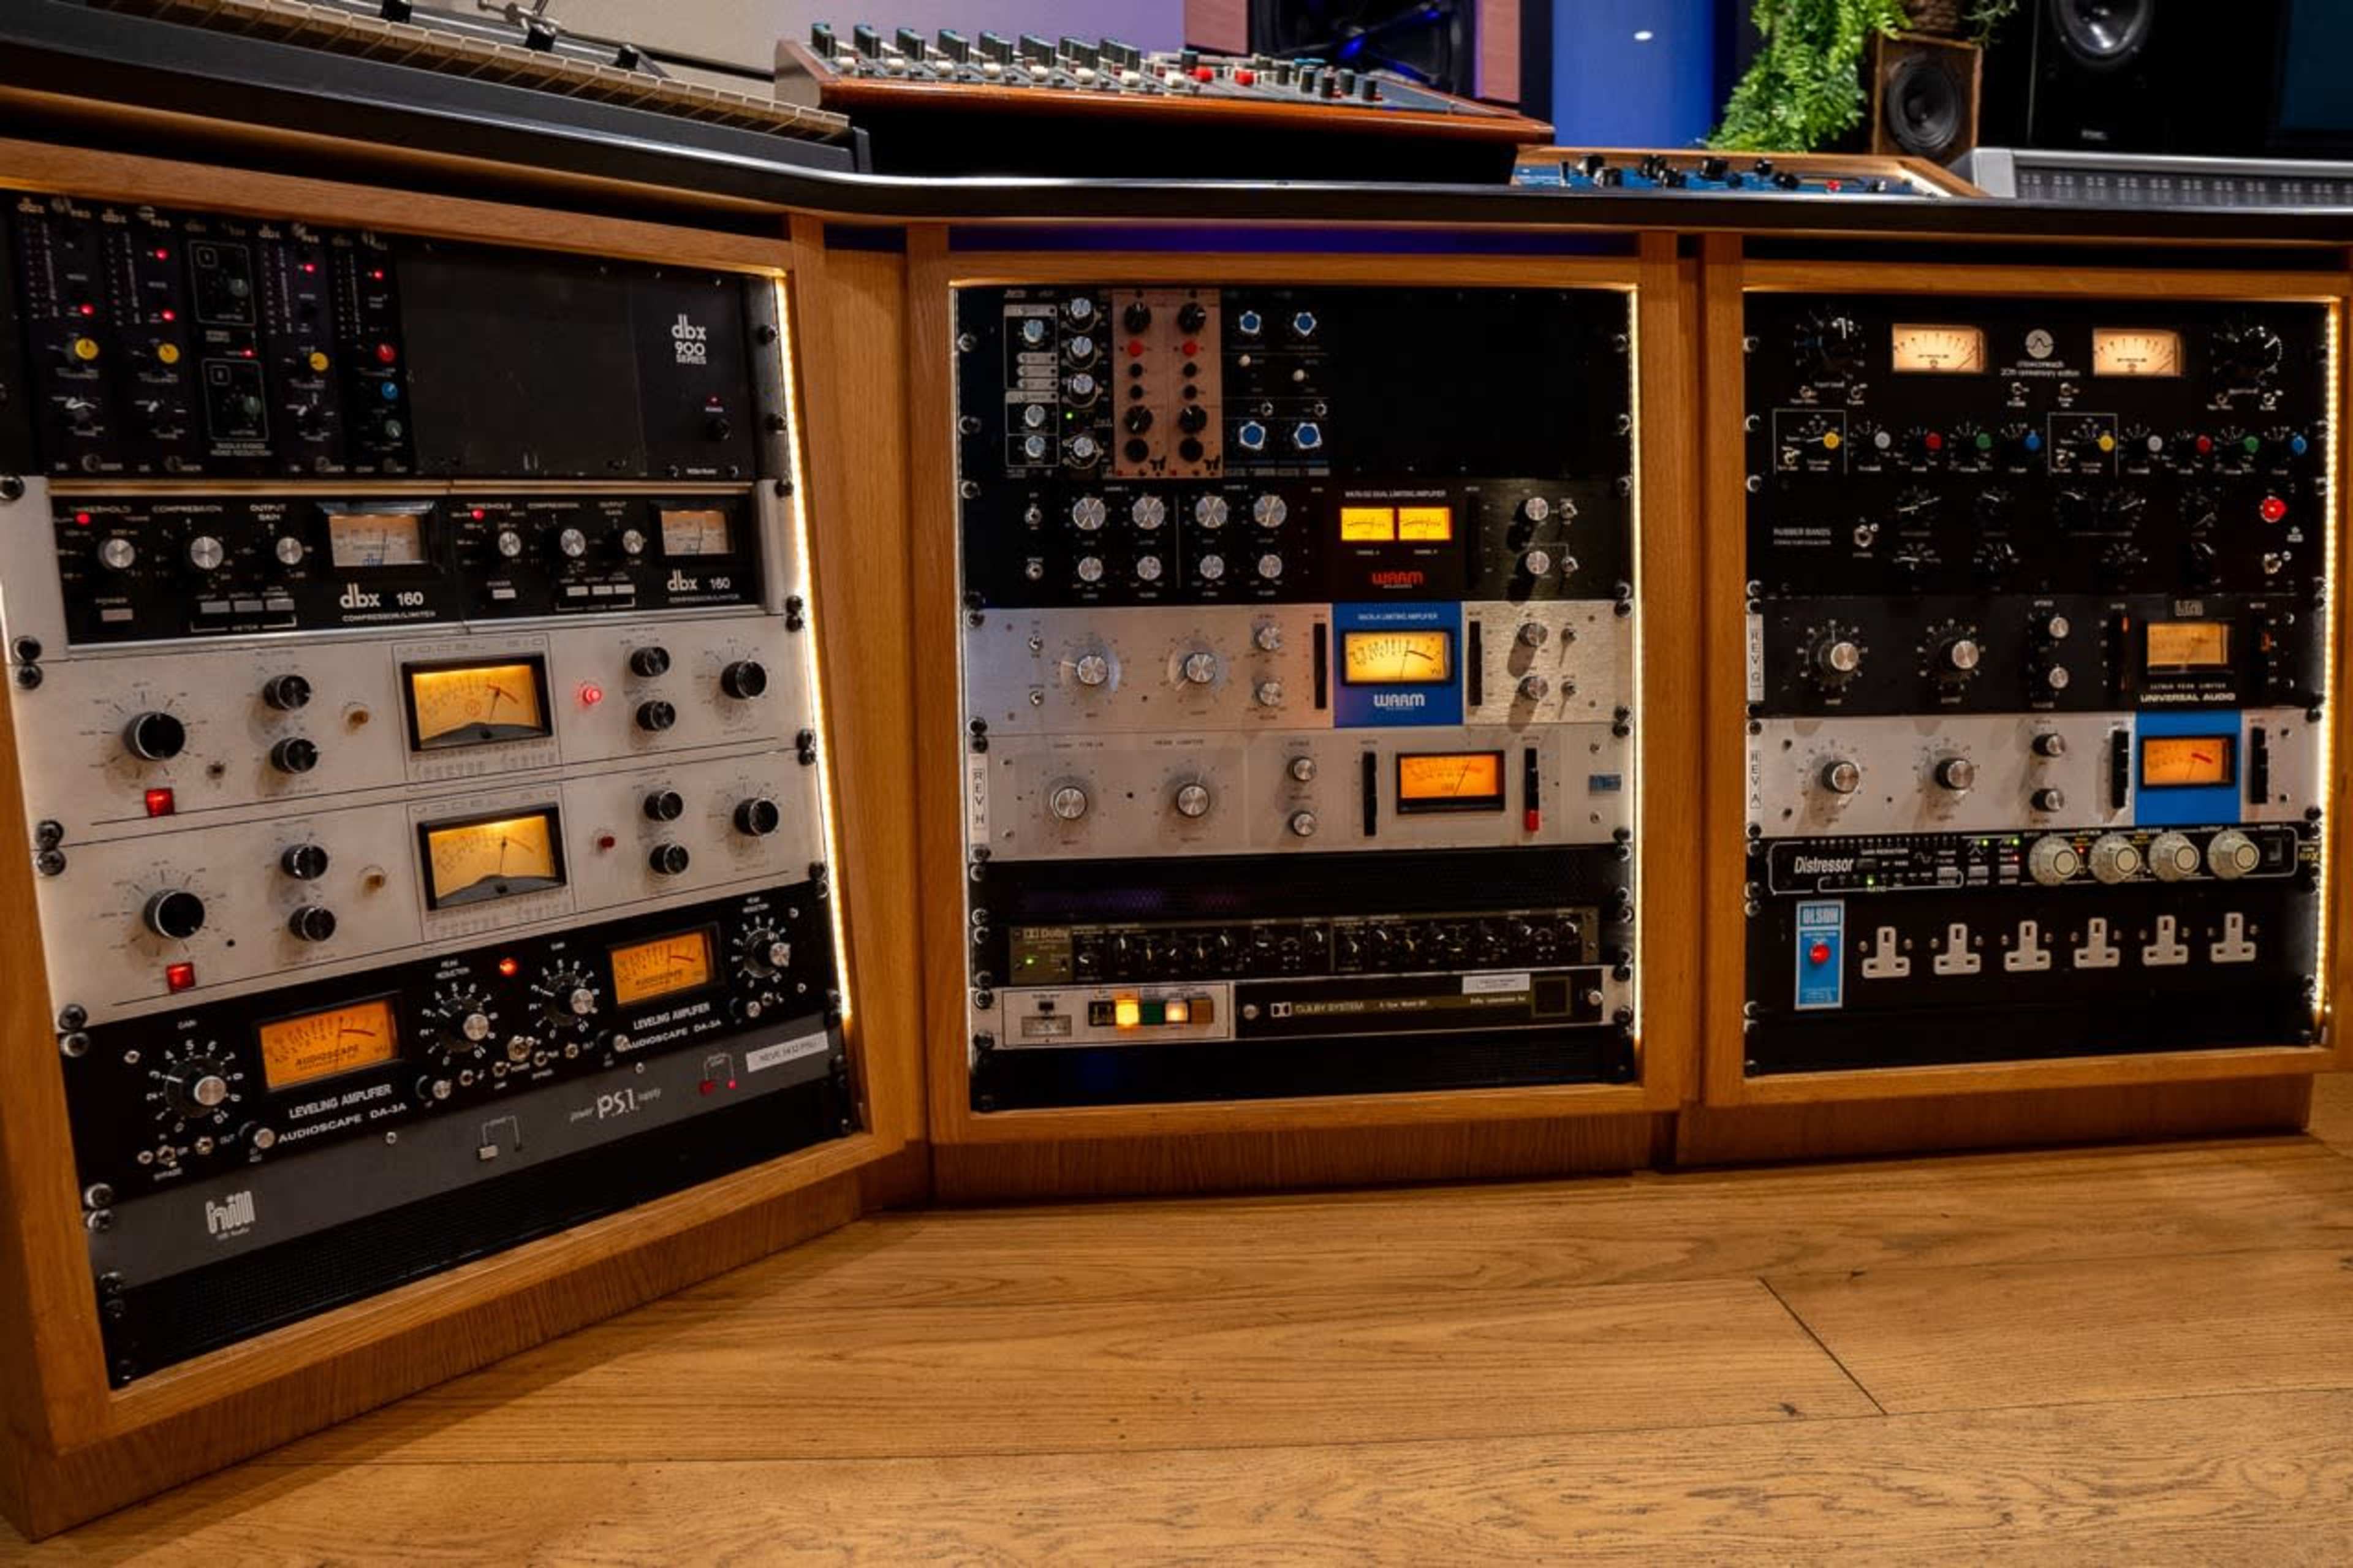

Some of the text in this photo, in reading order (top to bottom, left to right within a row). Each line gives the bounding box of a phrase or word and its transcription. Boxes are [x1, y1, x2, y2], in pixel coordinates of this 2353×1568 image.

[672, 314, 707, 341] dbx
[675, 341, 705, 354] 900
[676, 354, 707, 365] SERIES
[151, 505, 224, 513] COMPRESSION
[249, 503, 287, 512] OUTPUT
[1773, 527, 1832, 537] RUBBER BANDS
[666, 569, 731, 591] dbx 160
[1371, 570, 1423, 585] WARM
[339, 583, 424, 609] dbx 160
[341, 610, 436, 623] COMPRESSOR/LIMITER
[1373, 692, 1426, 708] WARM
[2140, 692, 2237, 703] UNIVERSAL AUDIO
[1794, 856, 1854, 874] Distressor
[1803, 907, 1839, 924] OLSON
[1327, 1001, 1365, 1013] SYSTEM
[632, 1011, 671, 1031] LEVELING
[185, 1040, 194, 1051] 5
[287, 1083, 393, 1121] LEVELING AMPLIFIER
[278, 1101, 408, 1145] AUDIOSCAPE DA-3A
